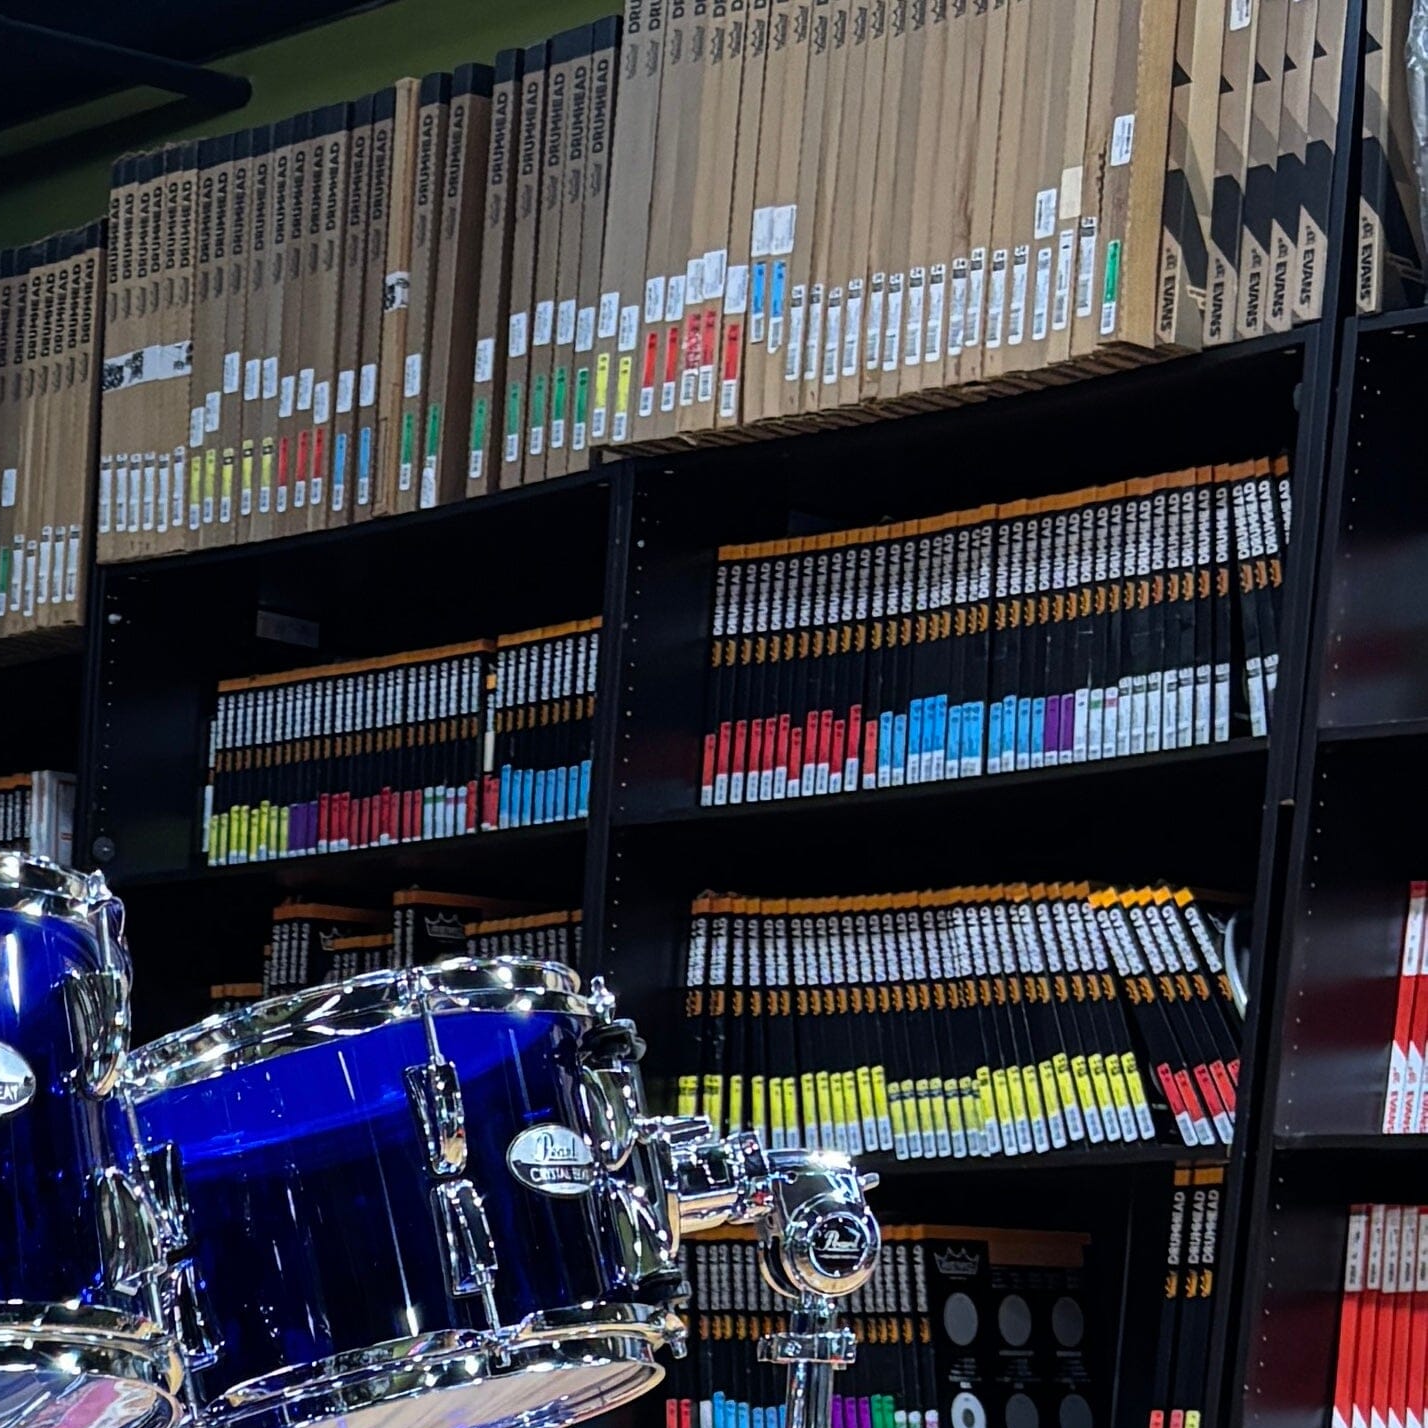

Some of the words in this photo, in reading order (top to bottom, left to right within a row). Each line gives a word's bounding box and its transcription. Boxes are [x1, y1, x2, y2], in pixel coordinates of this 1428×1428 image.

[448, 105, 465, 197] DRUMHEAD
[492, 92, 508, 185] DRUMHEAD
[523, 81, 538, 175] DRUMHEAD
[549, 72, 565, 166] DRUMHEAD
[571, 65, 586, 160] DRUMHEAD
[593, 59, 608, 153] DRUMHEAD
[419, 114, 433, 206] DRUMHEAD
[1160, 275, 1176, 333] EVANS
[1210, 283, 1225, 339] EVANS
[1246, 272, 1261, 330] EVANS
[1272, 261, 1288, 319] EVANS
[1299, 249, 1315, 306] EVANS
[1360, 243, 1374, 302] EVANS
